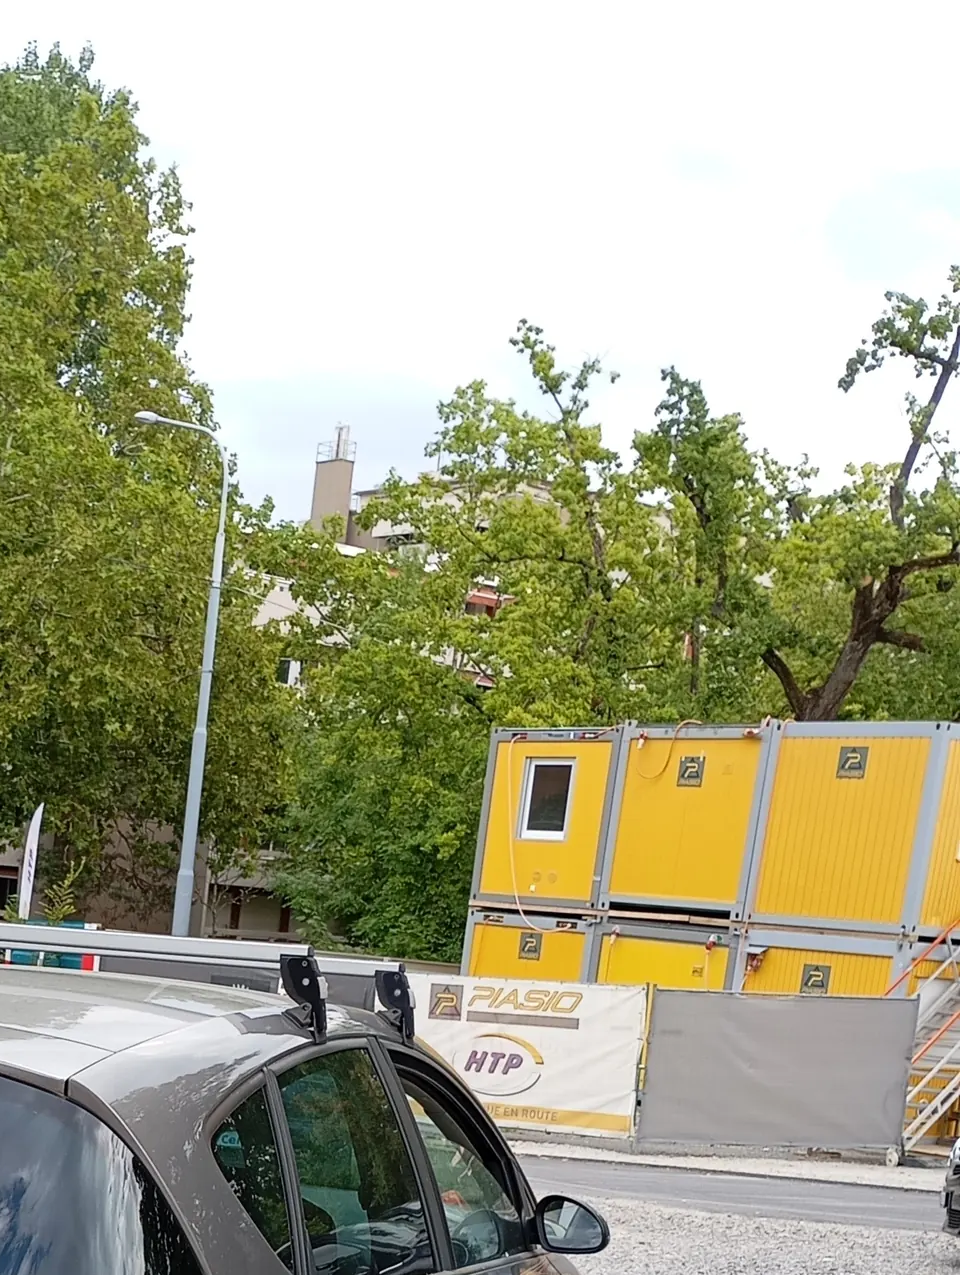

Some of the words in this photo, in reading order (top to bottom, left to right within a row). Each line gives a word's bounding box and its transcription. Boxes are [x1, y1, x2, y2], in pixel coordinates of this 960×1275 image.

[468, 986, 583, 1014] PIASIO
[464, 1050, 524, 1076] HTP
[503, 1107, 519, 1117] EN
[521, 1108, 559, 1122] ROUTE
